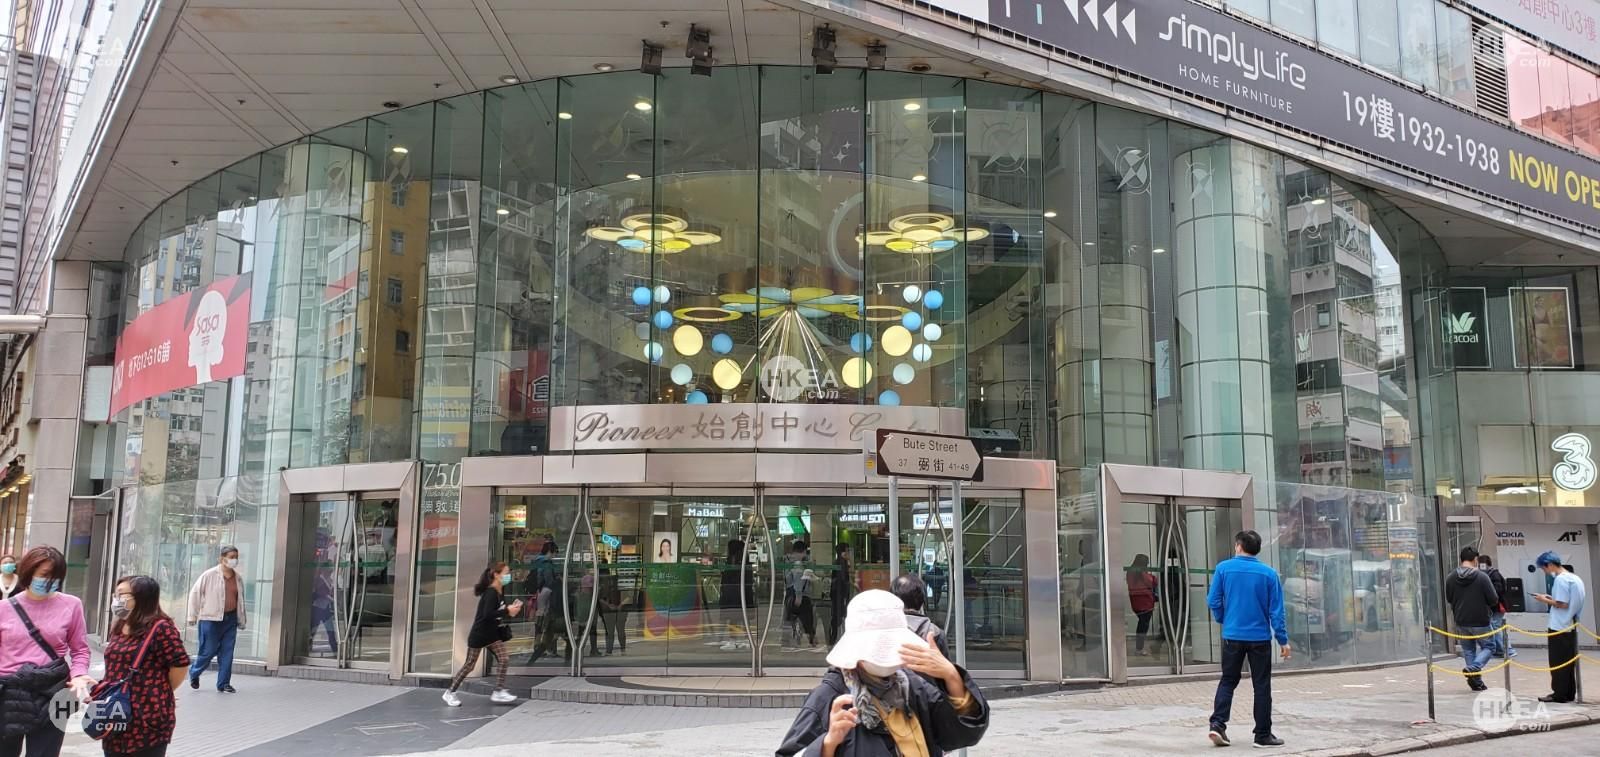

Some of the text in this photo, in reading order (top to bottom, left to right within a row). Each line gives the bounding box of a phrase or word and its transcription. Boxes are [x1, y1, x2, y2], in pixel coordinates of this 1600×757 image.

[1179, 63, 1293, 114] HOME FURNITURE
[1509, 150, 1559, 194] NOW
[574, 411, 685, 442] Pioneer
[690, 411, 838, 442] 始創中心
[903, 437, 958, 453] Bute Street
[898, 459, 908, 467] 37
[948, 463, 970, 472] 41-49
[688, 507, 725, 517] MaBell
